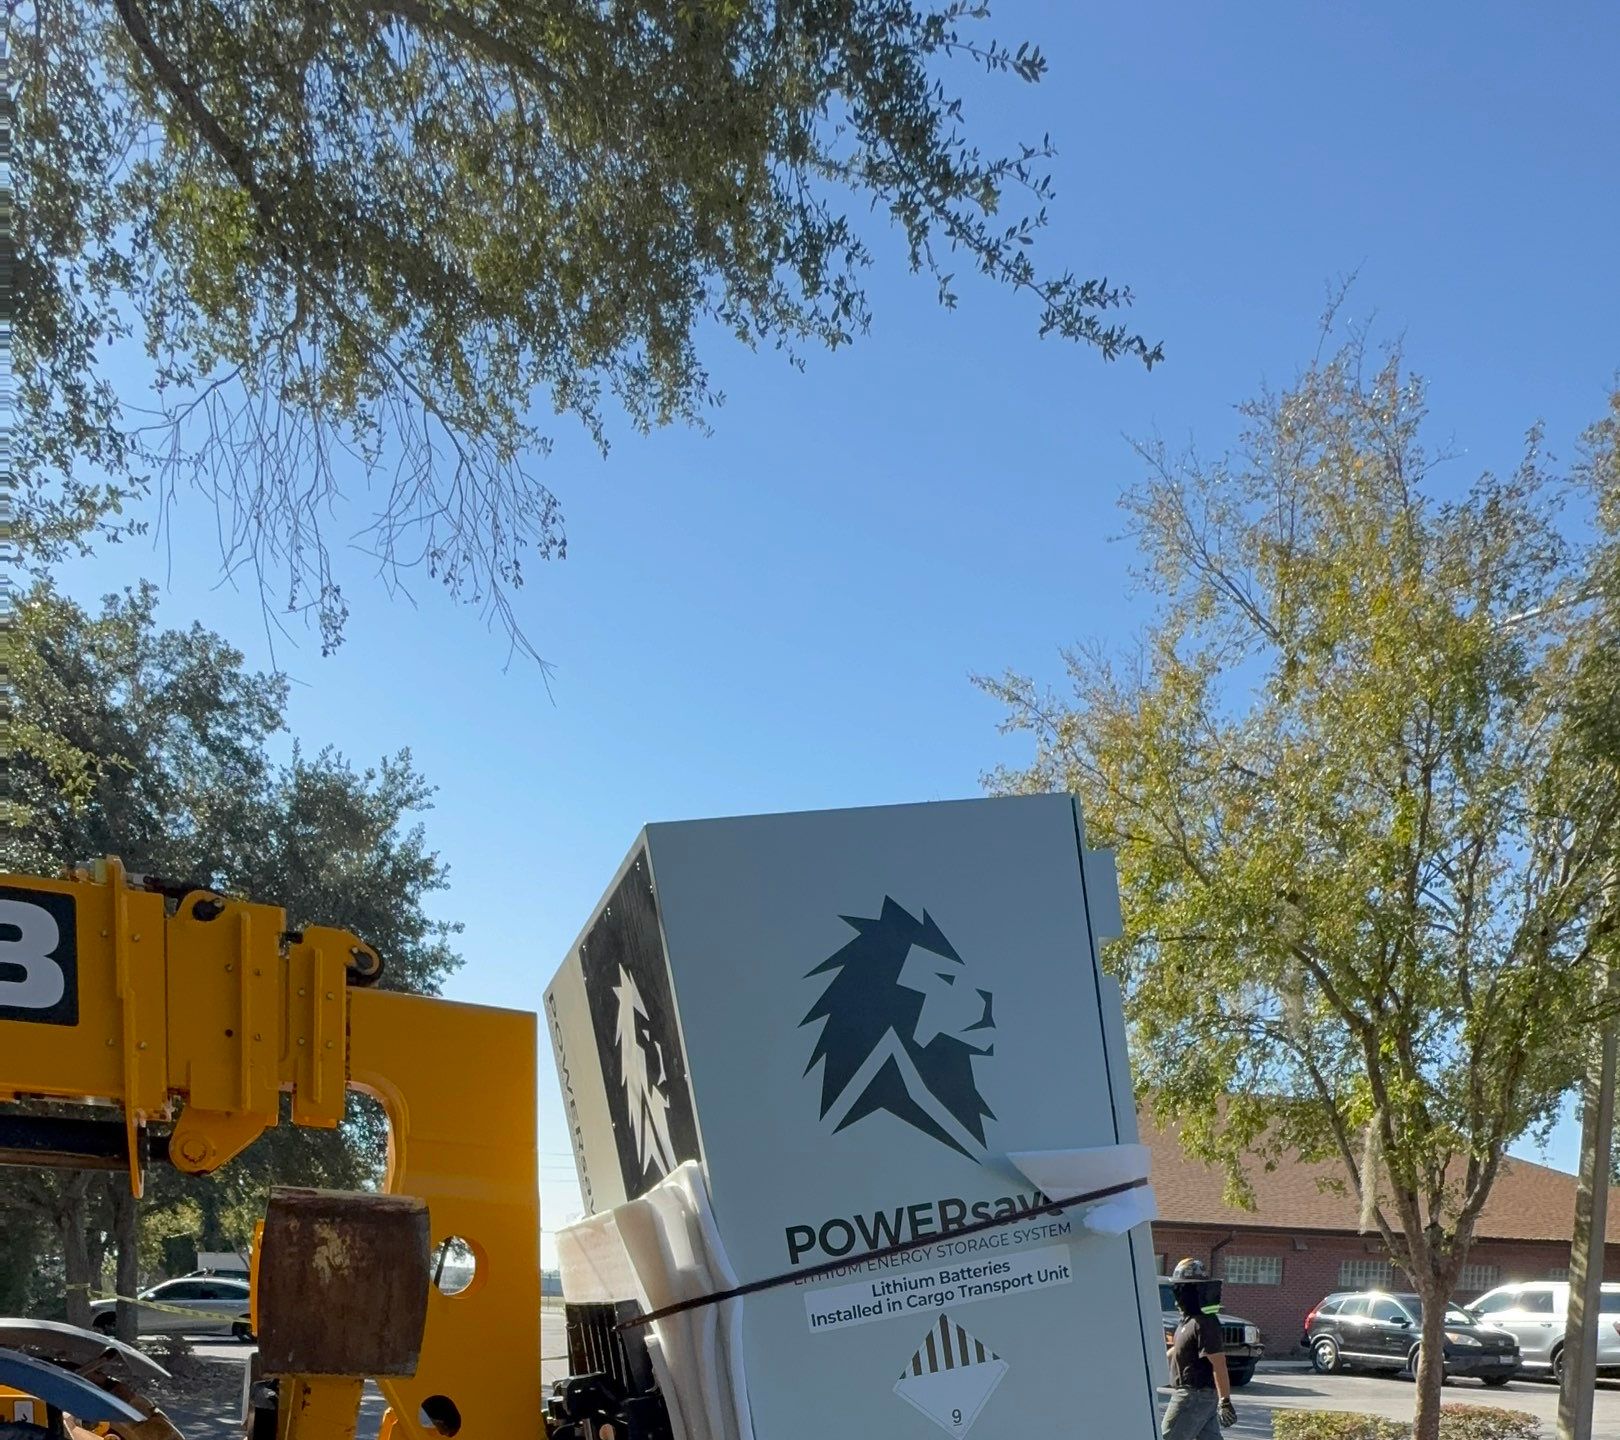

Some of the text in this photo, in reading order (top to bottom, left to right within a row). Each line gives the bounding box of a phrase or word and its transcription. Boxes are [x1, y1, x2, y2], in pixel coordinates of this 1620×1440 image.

[0, 899, 65, 1009] B
[785, 1191, 1064, 1265] POWERsav
[867, 1248, 933, 1272] ENERGY
[937, 1233, 1009, 1259] STORAGE
[1013, 1222, 1072, 1244] SYSTEM
[811, 1264, 1070, 1327] Installed in Cargo Transport Unit
[871, 1260, 1011, 1298] Lithium Batteries
[951, 1408, 962, 1424] 9
